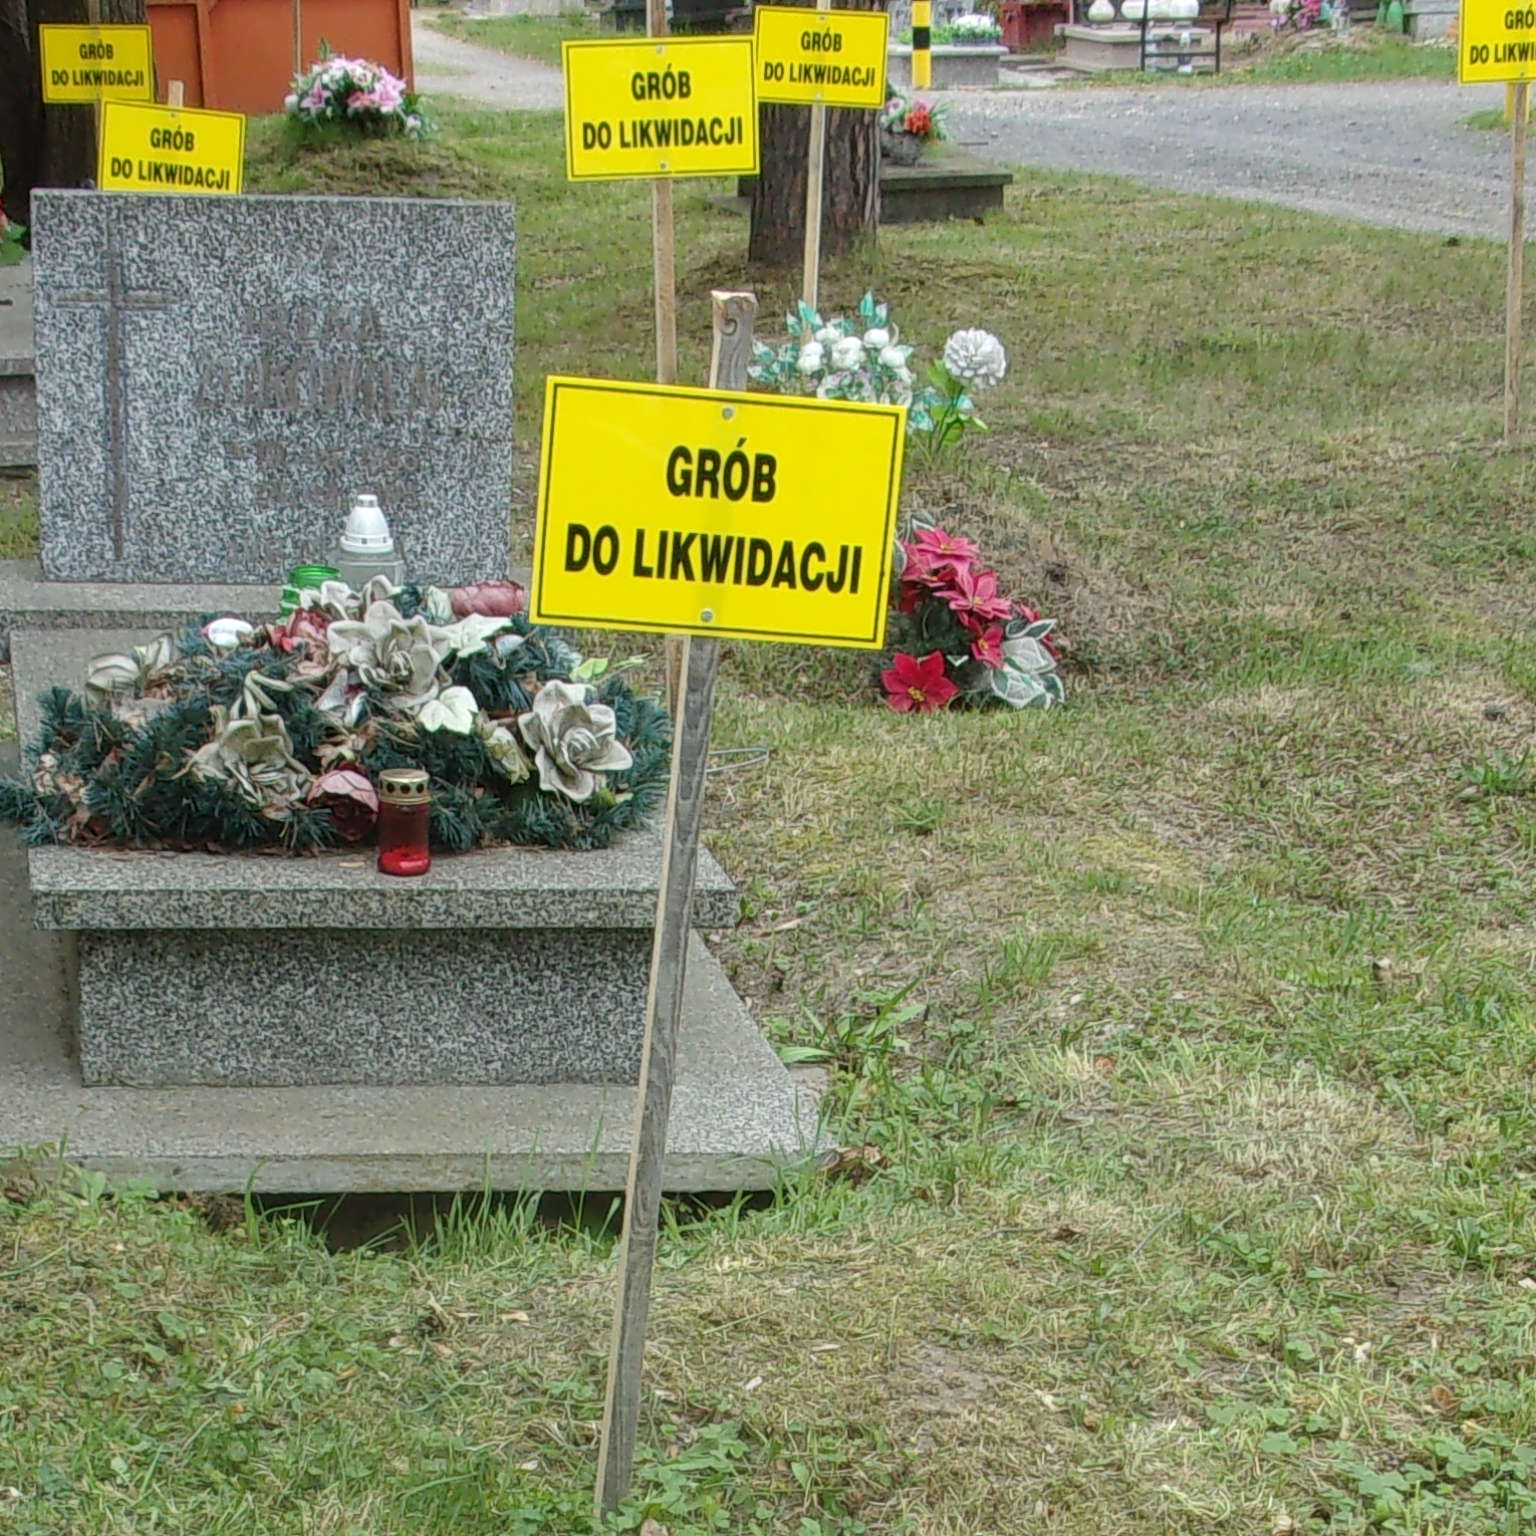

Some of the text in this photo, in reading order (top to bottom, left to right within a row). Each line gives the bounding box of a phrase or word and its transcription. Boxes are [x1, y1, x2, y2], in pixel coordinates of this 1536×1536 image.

[79, 39, 114, 61] GRÓB
[800, 28, 843, 52] GRÓB
[1469, 44, 1490, 65] DO
[51, 70, 145, 87] DO LIKWIDACJI
[631, 64, 692, 101] GRÓB
[763, 61, 876, 87] DO LIKWIDACJI
[149, 125, 196, 152] GRÓB
[582, 116, 744, 150] DO LIKWIDACJI
[110, 157, 231, 191] DO LIKWIDACJI
[666, 437, 778, 504] GRÓB
[563, 522, 863, 595] DO LIKWIDACJI
